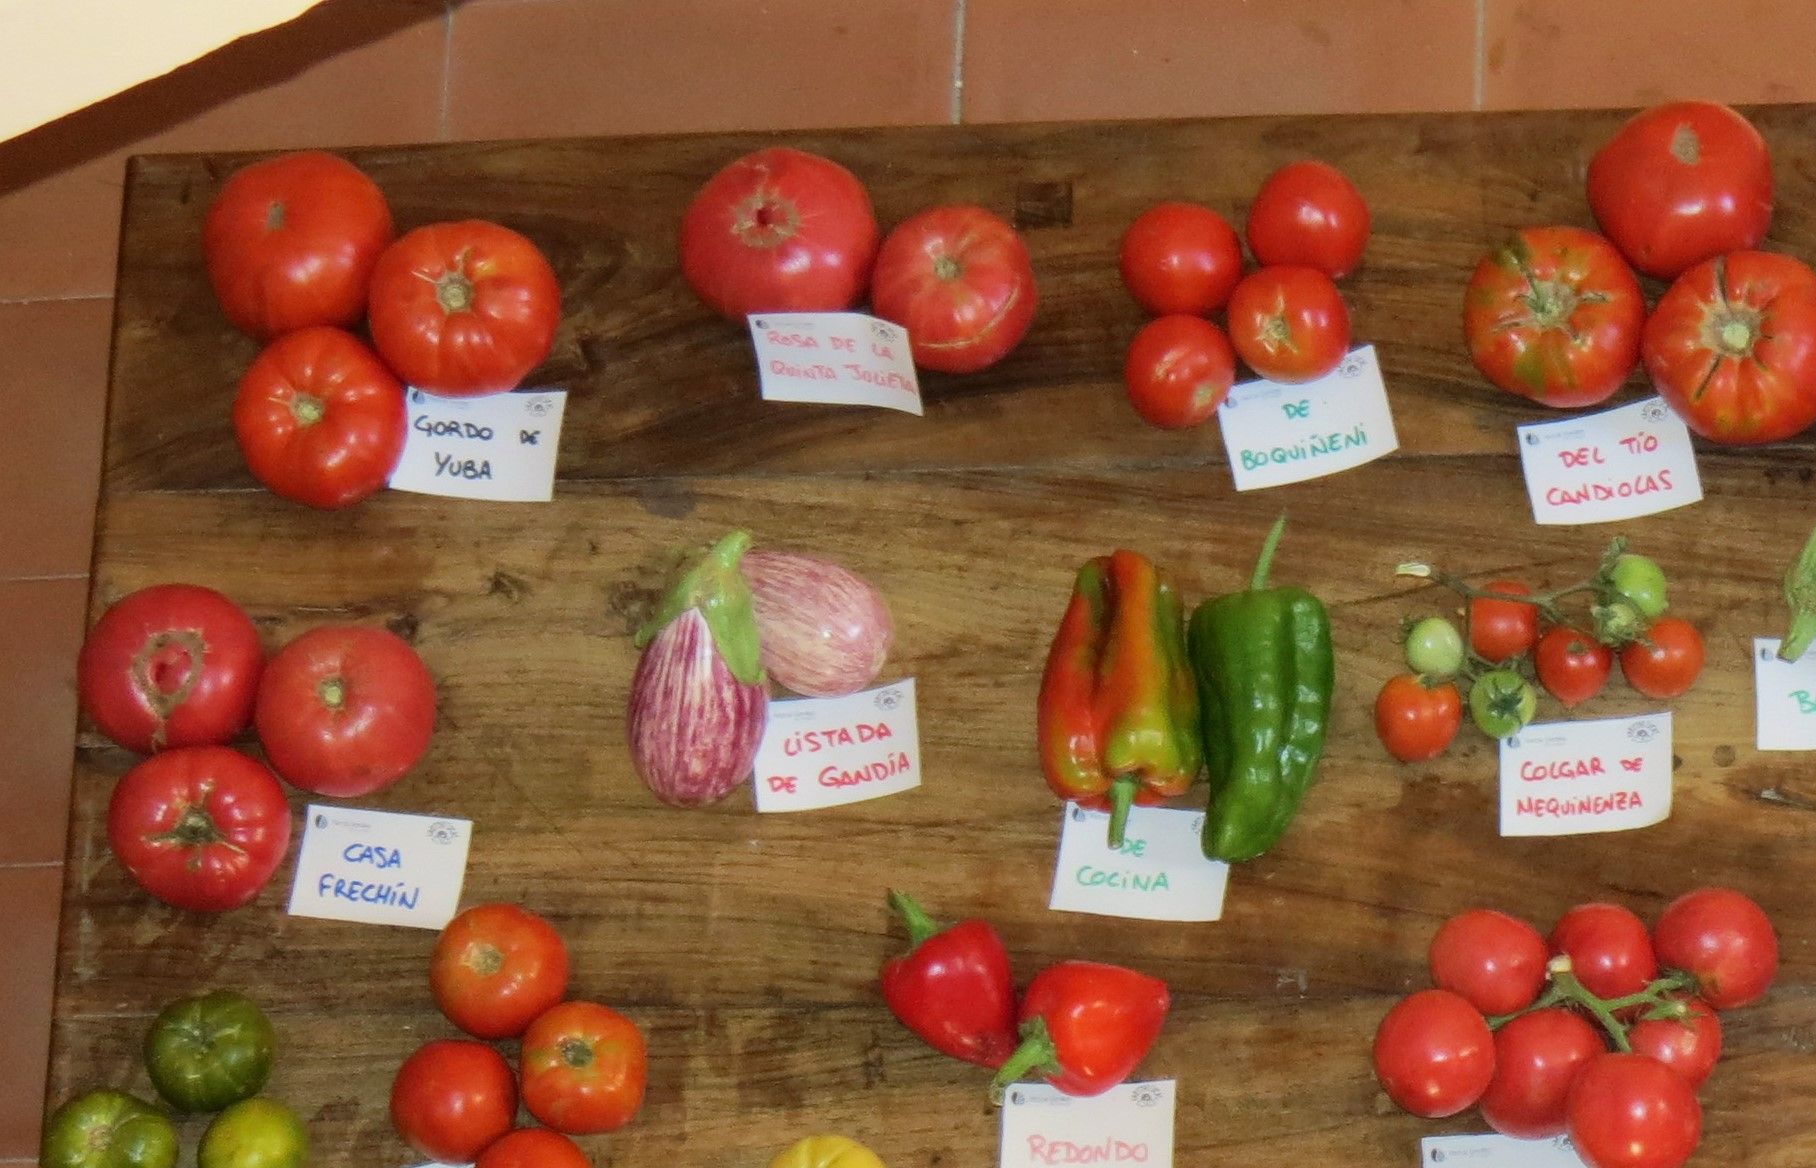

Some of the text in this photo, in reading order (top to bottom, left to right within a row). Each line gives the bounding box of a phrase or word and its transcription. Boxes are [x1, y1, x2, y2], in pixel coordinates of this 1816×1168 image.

[767, 331, 895, 360] ROSA DE LA
[1284, 399, 1310, 419] DE
[414, 415, 541, 445] GORDO DE
[1241, 422, 1368, 470] BOQUIÑENI
[1559, 446, 1605, 468] DEL
[434, 452, 492, 480] YUBA
[1546, 470, 1673, 507] CANDIOLAS
[784, 723, 893, 757] LISTADA
[1520, 756, 1644, 783] COLGAR DE
[767, 774, 797, 794] DE
[1516, 790, 1643, 817] MEQUINENZA
[344, 844, 402, 869] CASA
[1116, 834, 1145, 858] DE
[1076, 860, 1170, 891] COCINA
[1027, 1133, 1149, 1165] REDONDO
